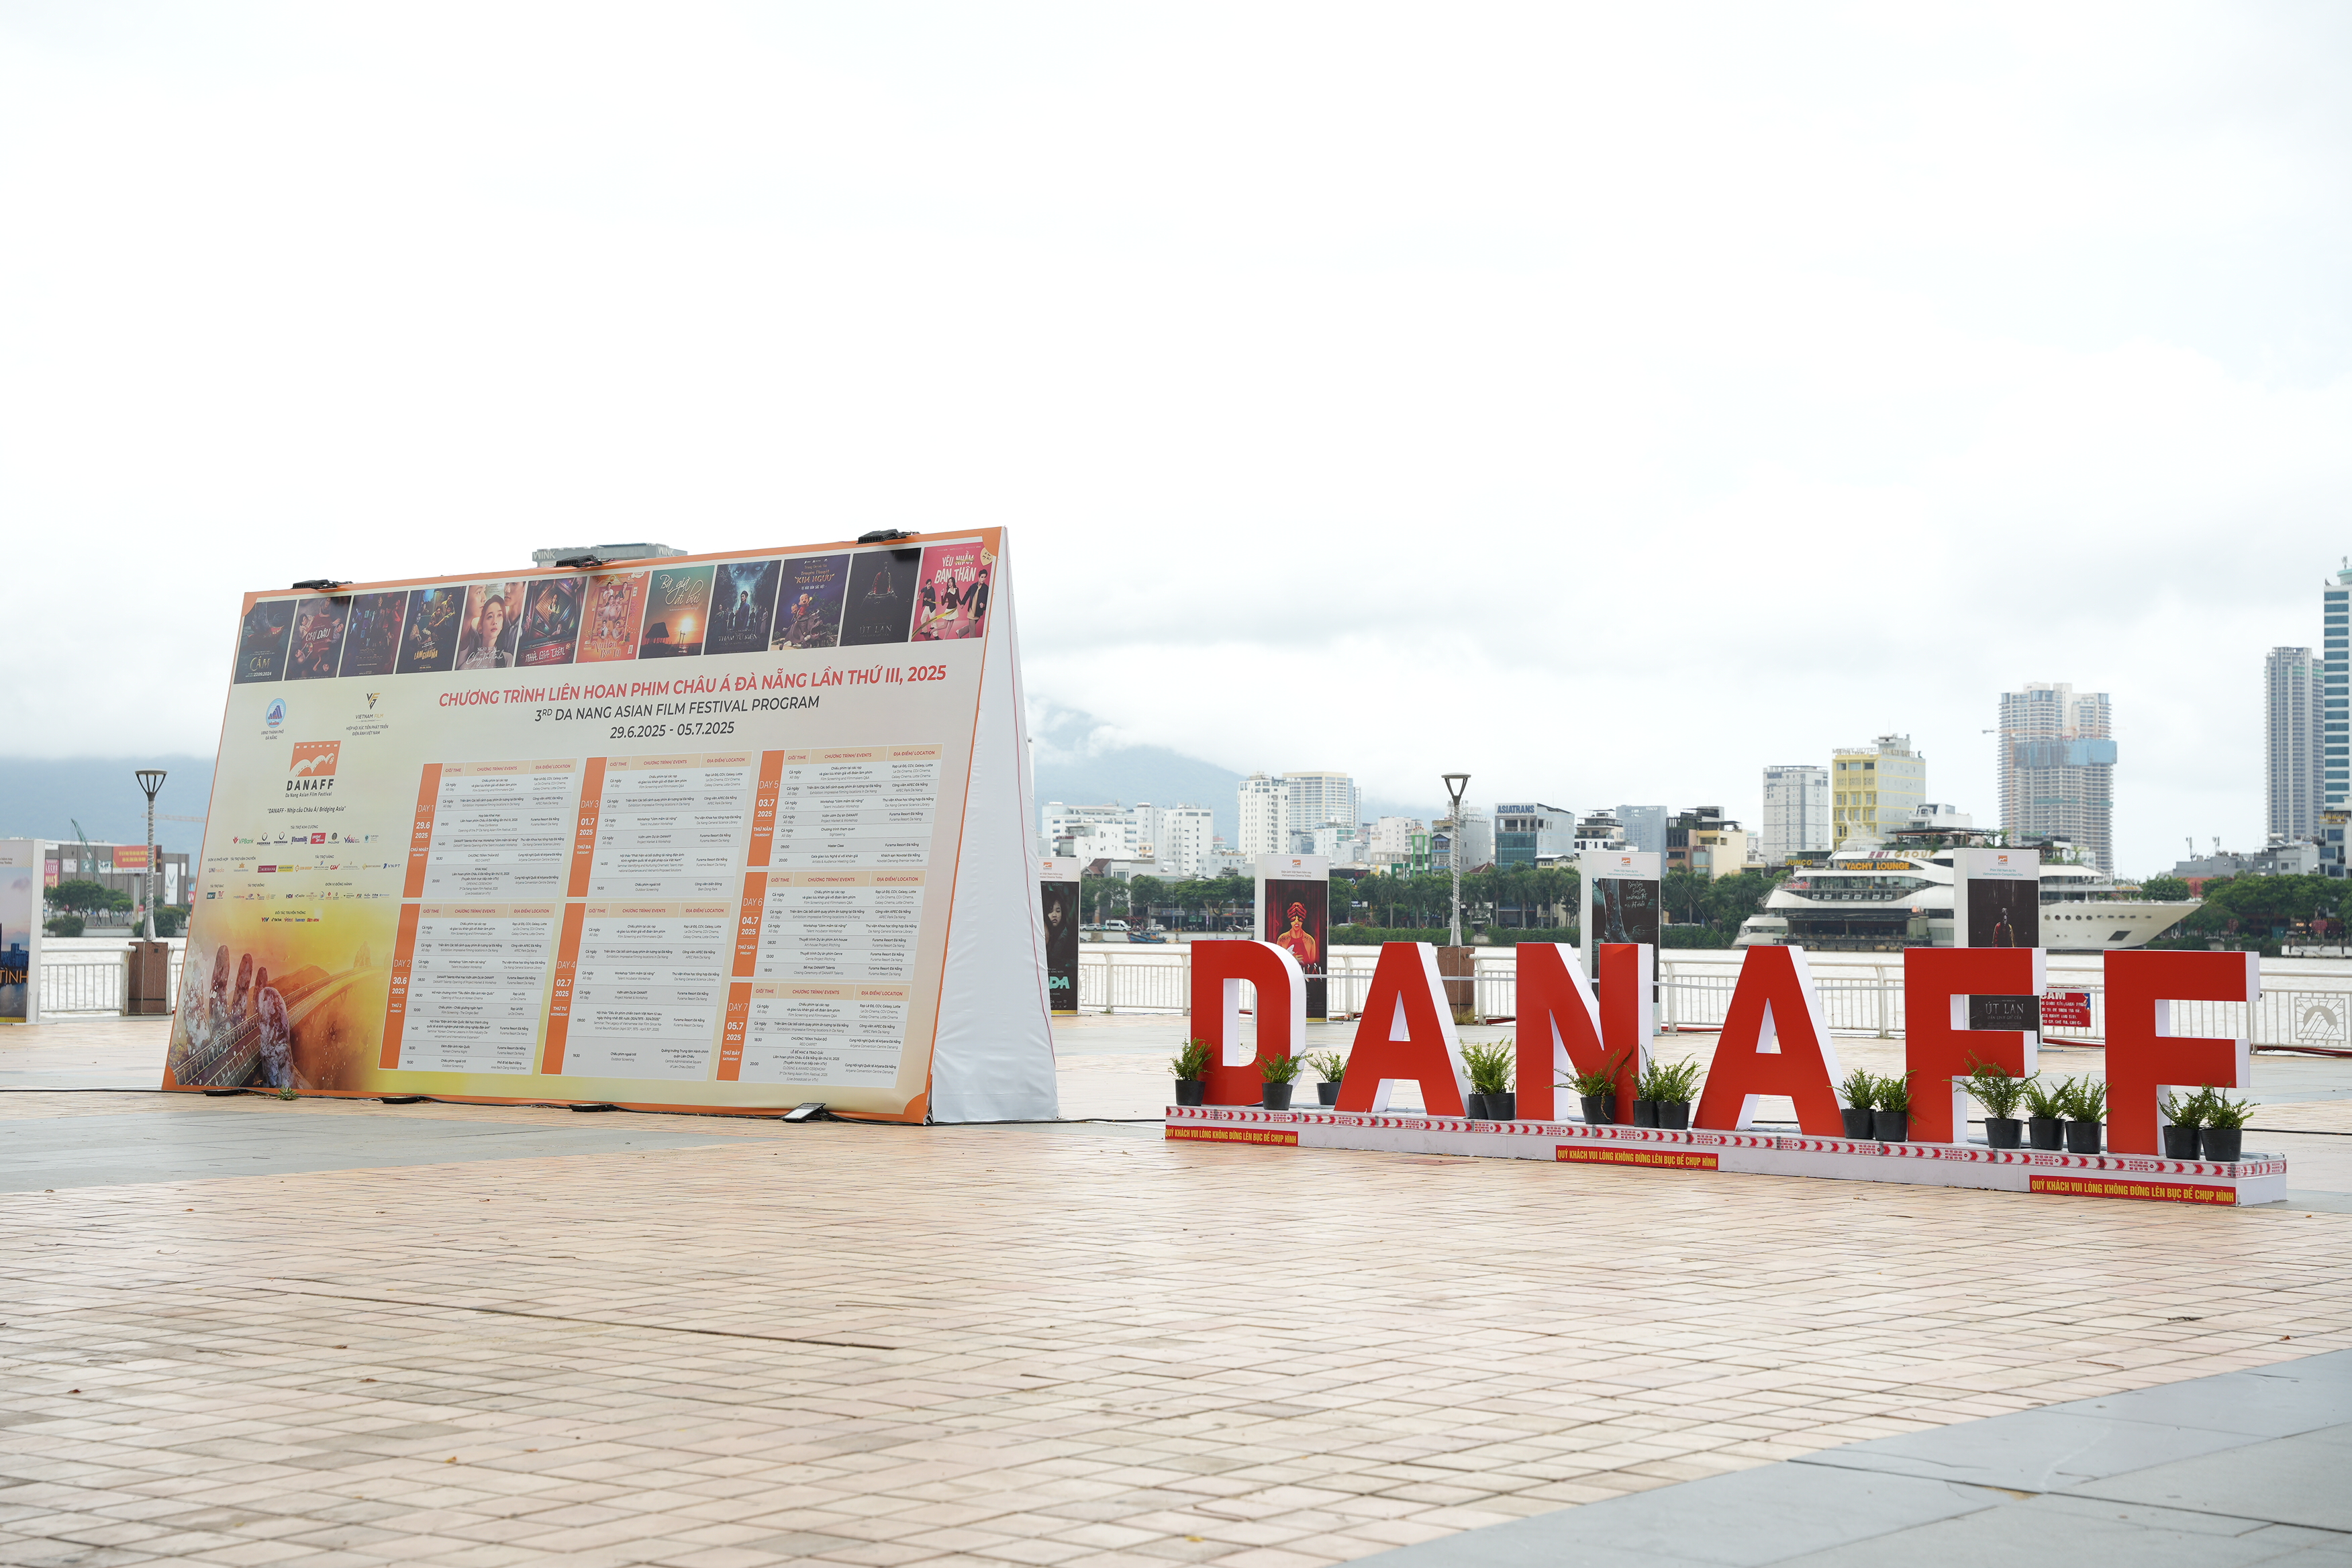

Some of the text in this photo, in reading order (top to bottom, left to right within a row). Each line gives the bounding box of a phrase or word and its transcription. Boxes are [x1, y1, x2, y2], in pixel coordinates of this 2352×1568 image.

[533, 551, 556, 560] WINK
[657, 546, 674, 556] WINK
[942, 554, 954, 567] YÊU
[934, 566, 977, 584] BẠN THÂN
[660, 575, 673, 593] Bà
[674, 580, 703, 605] đi bụi
[306, 628, 330, 641] CHỊ DÂU
[875, 625, 892, 633] LAN
[439, 665, 946, 707] CHƯƠNG TRÌNH LIÊN HOAN PHIM CHÂU Á ĐÀ NẴNG LẦN THỨ III, 2025
[535, 696, 820, 722] 3RD DA NANG ASIAN FILM FESTIVAL PROGRAM
[609, 724, 666, 738] 29.6.2025
[677, 722, 734, 736] 05.7.2025
[287, 779, 334, 791] DANAFF
[759, 780, 779, 789] DAY 5
[758, 799, 775, 807] 03.7
[1498, 805, 1534, 813] ASIATRANS
[416, 822, 430, 830] 29.6
[743, 898, 763, 906] DAY 6
[742, 916, 758, 924] 04.7
[556, 979, 571, 987] 02.7
[728, 1003, 748, 1011] DAY 7
[1986, 1001, 2024, 1014] ÚT LAN
[727, 1022, 744, 1030] 05.7
[1165, 1128, 1173, 1137] QUÝ
[1175, 1128, 1189, 1138] KHÁCH
[1199, 1129, 1211, 1138] LÒNG
[1212, 1130, 1228, 1140] KHÔNG
[1229, 1130, 1242, 1140] ĐỨNG
[1243, 1130, 1252, 1141] LÊN
[1253, 1132, 1263, 1142] BỤC
[1264, 1131, 1270, 1142] ĐỂ
[1271, 1134, 1283, 1144] CHỤP
[1285, 1134, 1296, 1144] HÌNH
[1558, 1148, 1716, 1167] QUÝ KHÁCH VUI LÒNG KHÔNG ĐỨNG LÊN BỤC ĐỂ CHỤP HÌNH
[2032, 1179, 2234, 1202] QUÝ KHÁCH VUI LÒNG KHÔNG ĐỨNG LÊN BỤC ĐỂ CHỤP HÌNH
